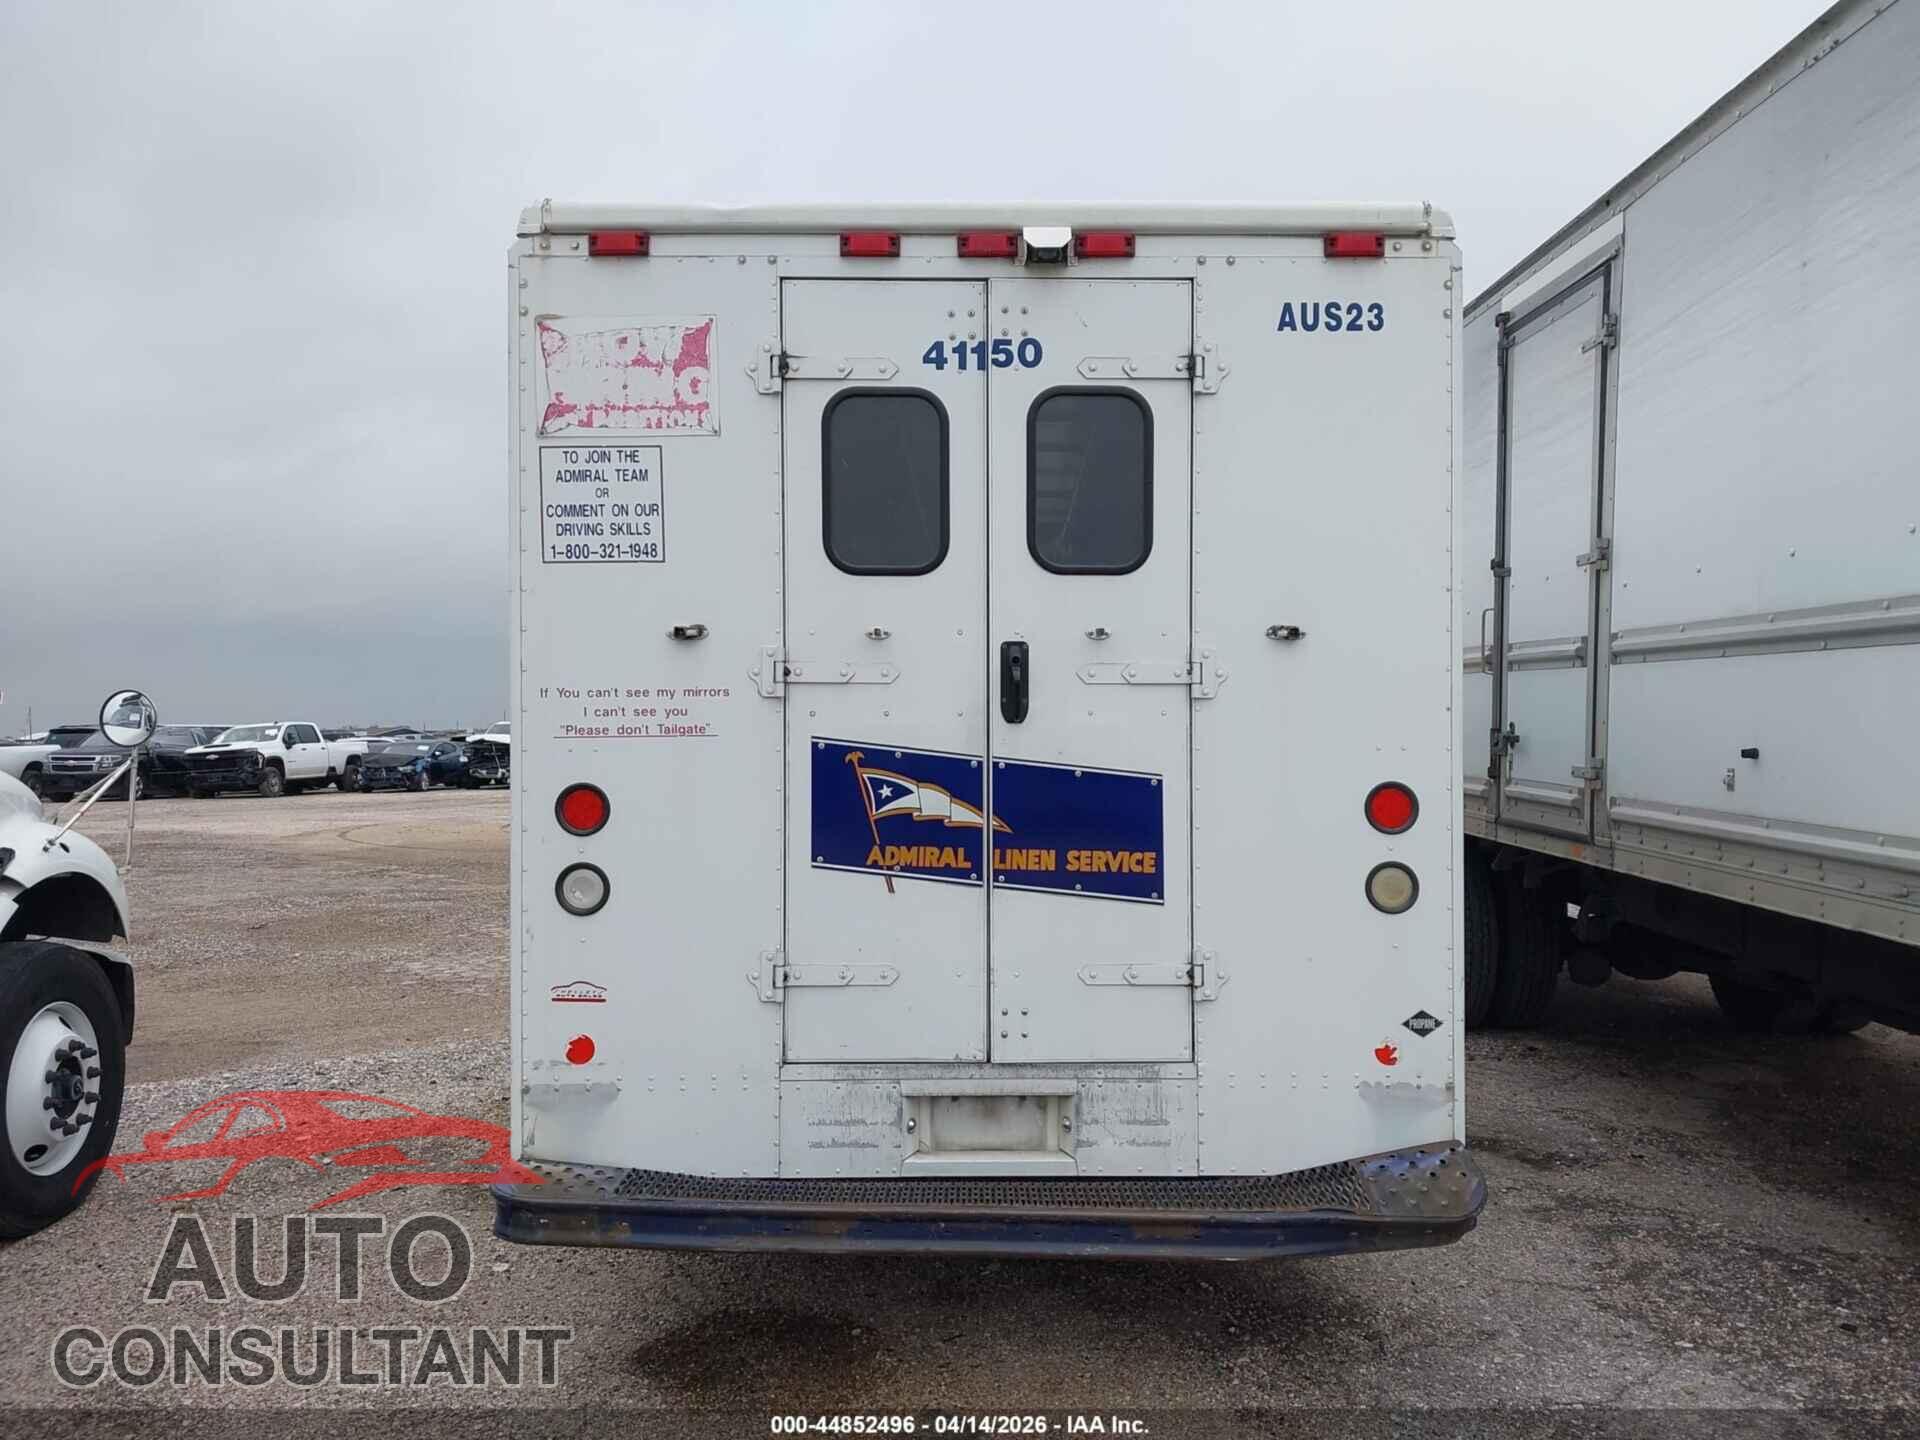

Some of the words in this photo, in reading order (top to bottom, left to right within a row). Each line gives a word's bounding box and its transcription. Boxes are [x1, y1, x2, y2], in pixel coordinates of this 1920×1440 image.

[1276, 302, 1385, 332] AUS23
[922, 336, 1043, 371] 41150
[562, 451, 579, 464] TO
[585, 450, 611, 464] JOIN
[618, 450, 640, 463] THE
[555, 469, 608, 483] ADMIRAL
[615, 469, 649, 482] TEAM
[595, 488, 610, 499] OR
[546, 504, 606, 518] COMMENT
[612, 504, 630, 517] ON
[634, 503, 660, 517] OUR
[556, 523, 604, 537] DRIVING
[610, 522, 651, 536] SKILLS
[551, 543, 658, 560] 1-800-321-1948
[540, 688, 549, 698] If
[556, 688, 580, 699] You
[587, 688, 619, 698] can't
[626, 689, 650, 698] see
[656, 689, 676, 700] my
[683, 686, 730, 697] mirrors
[594, 707, 626, 717] can't
[633, 708, 657, 717] see
[664, 708, 688, 719] you
[560, 725, 609, 736] "Please
[616, 724, 649, 735] don't
[656, 723, 711, 737] Tailgate"
[866, 845, 972, 869] ADMIRAL
[993, 848, 1056, 871] LINEN
[1065, 850, 1156, 873] SERVICE
